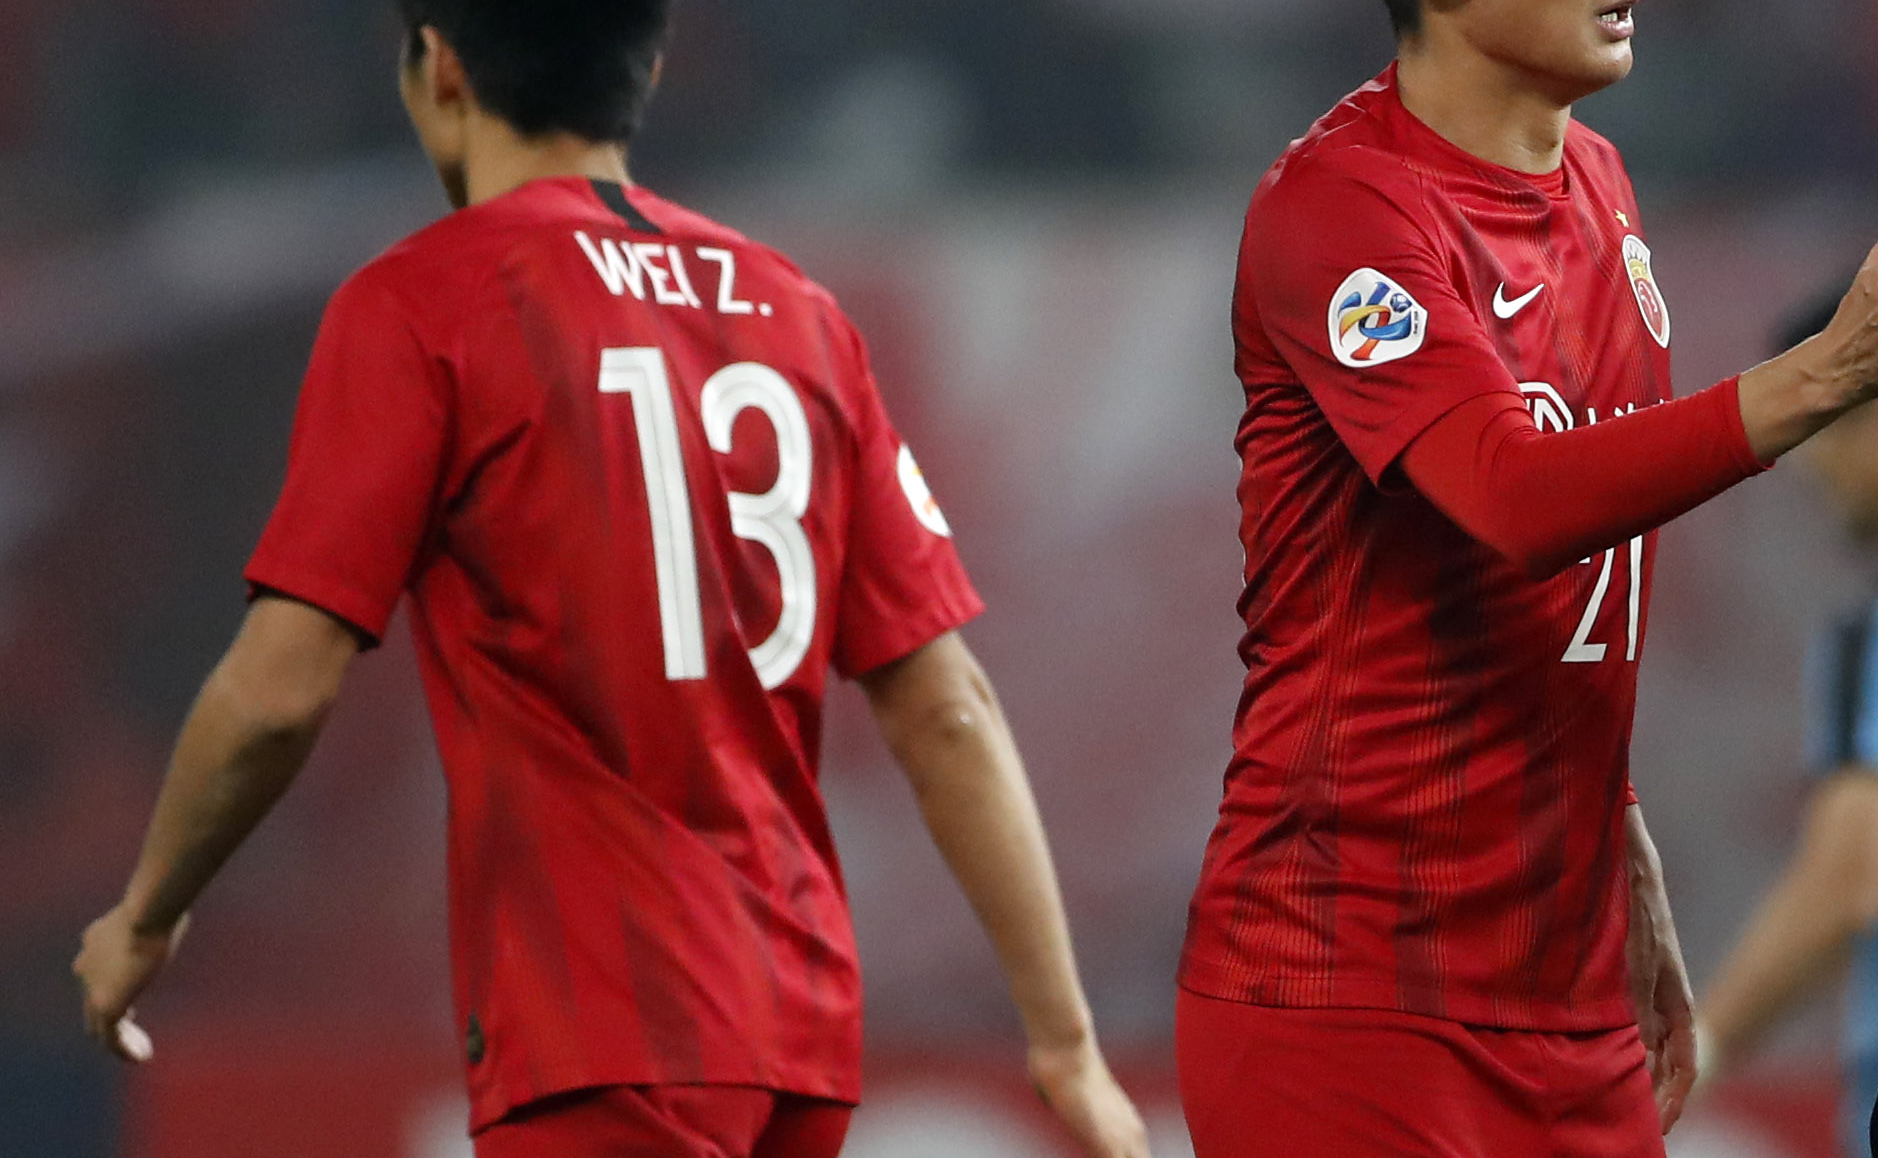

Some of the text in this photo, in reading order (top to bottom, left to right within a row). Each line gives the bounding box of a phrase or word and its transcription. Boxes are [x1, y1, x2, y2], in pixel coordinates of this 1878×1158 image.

[573, 229, 774, 317] WEI Z.
[598, 346, 816, 690] 13
